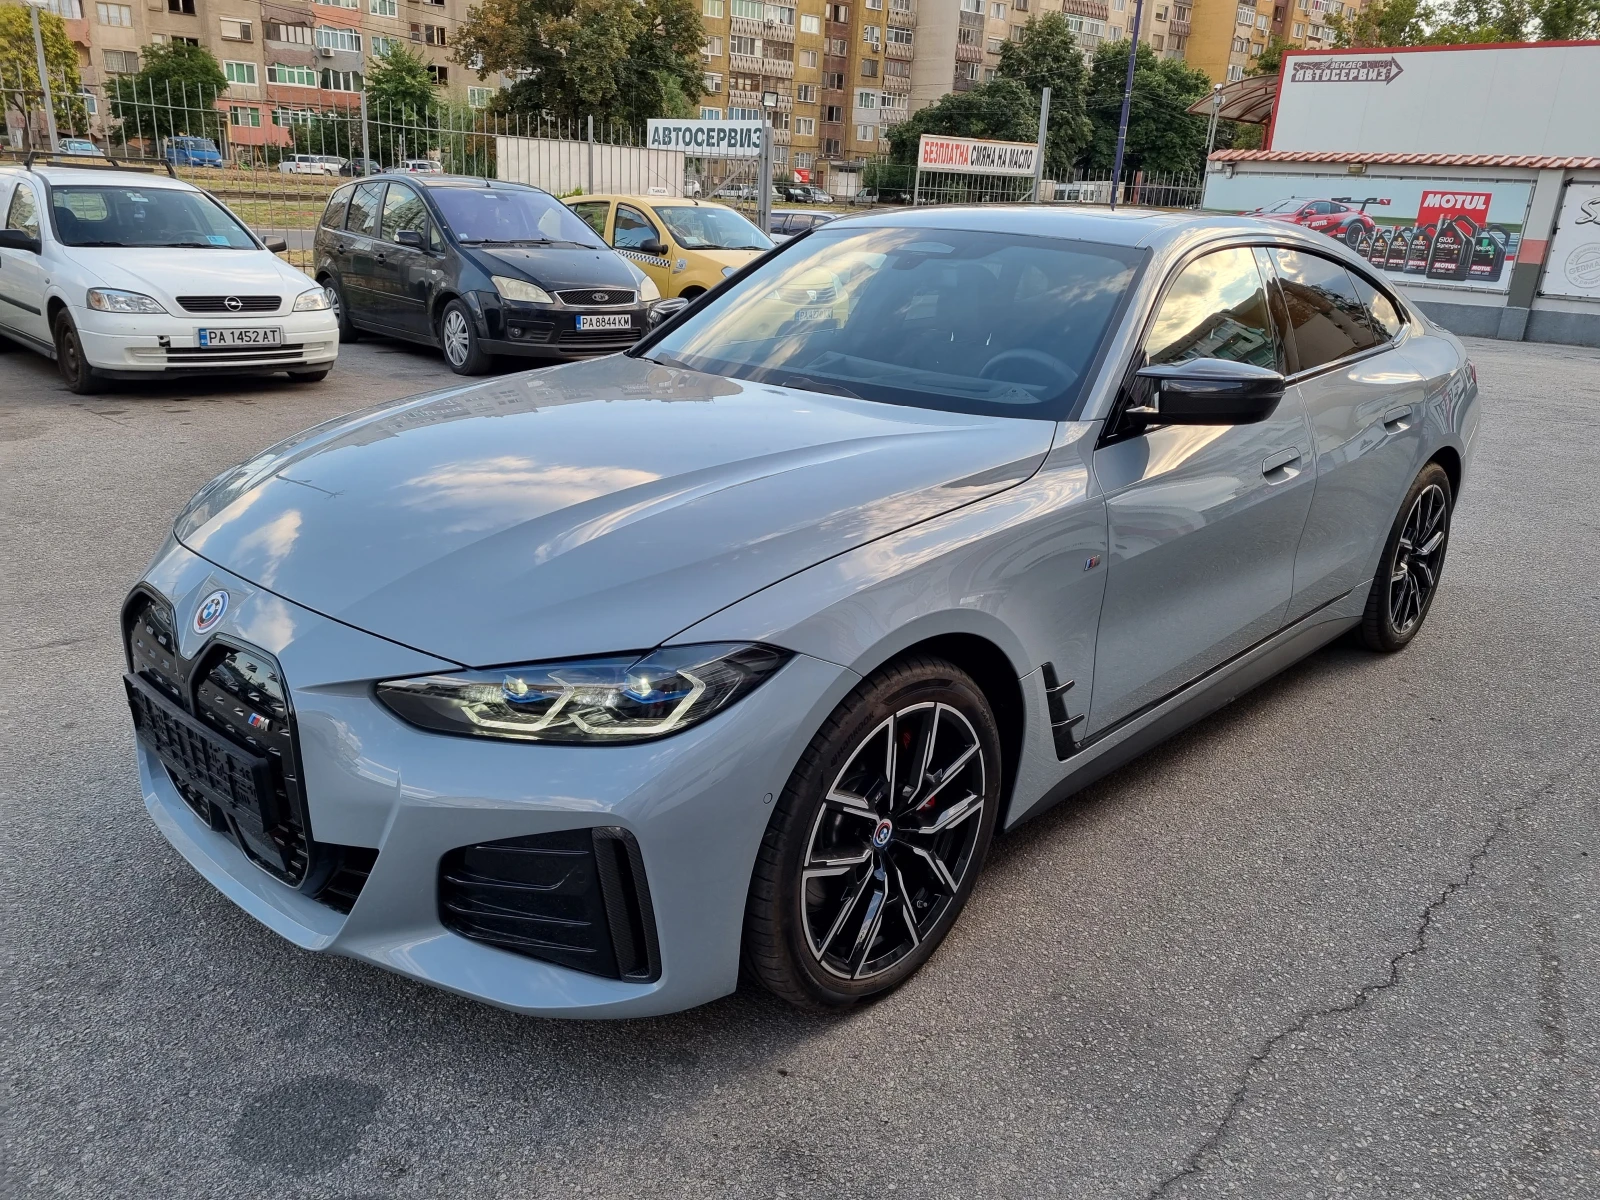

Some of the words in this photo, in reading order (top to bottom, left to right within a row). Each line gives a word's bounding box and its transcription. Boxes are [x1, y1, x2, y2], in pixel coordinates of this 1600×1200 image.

[1295, 68, 1387, 81] АВТОСЕРВИЗ
[651, 126, 762, 148] АВТОСЕРВИЗ
[923, 141, 969, 166] БЕЗПЛАТНА
[970, 145, 996, 167] СМЯНА
[996, 147, 1007, 168] НА
[1007, 148, 1033, 169] МАСЛО
[1422, 193, 1486, 210] MOTUL
[582, 317, 594, 328] PA
[595, 317, 617, 327] 8844
[618, 316, 630, 327] KM
[209, 331, 226, 343] PA
[230, 331, 260, 343] 1452
[262, 330, 278, 343] AT
